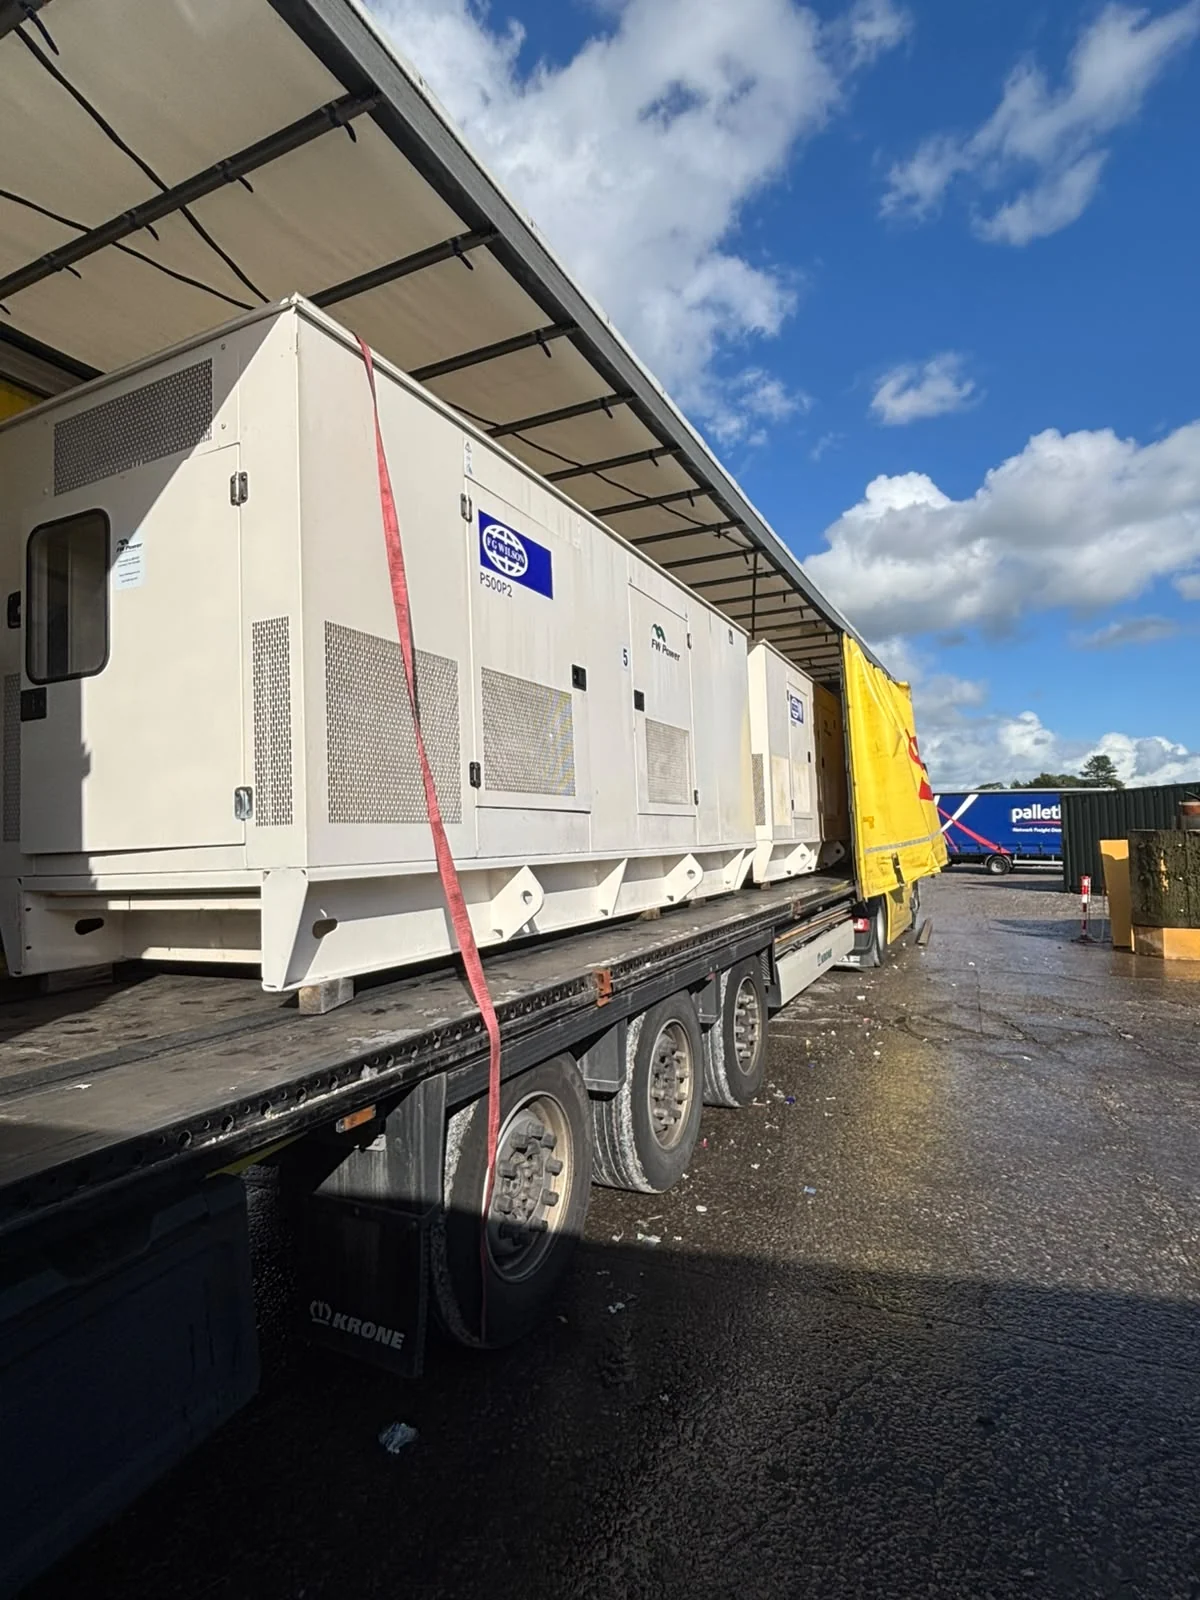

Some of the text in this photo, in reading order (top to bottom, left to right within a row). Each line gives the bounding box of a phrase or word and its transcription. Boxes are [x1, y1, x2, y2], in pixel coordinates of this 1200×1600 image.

[498, 542, 525, 564] WILSON
[480, 571, 513, 598] P500P2
[623, 648, 628, 667] 5
[651, 638, 681, 662] FW Power
[332, 1312, 406, 1350] KRONE
